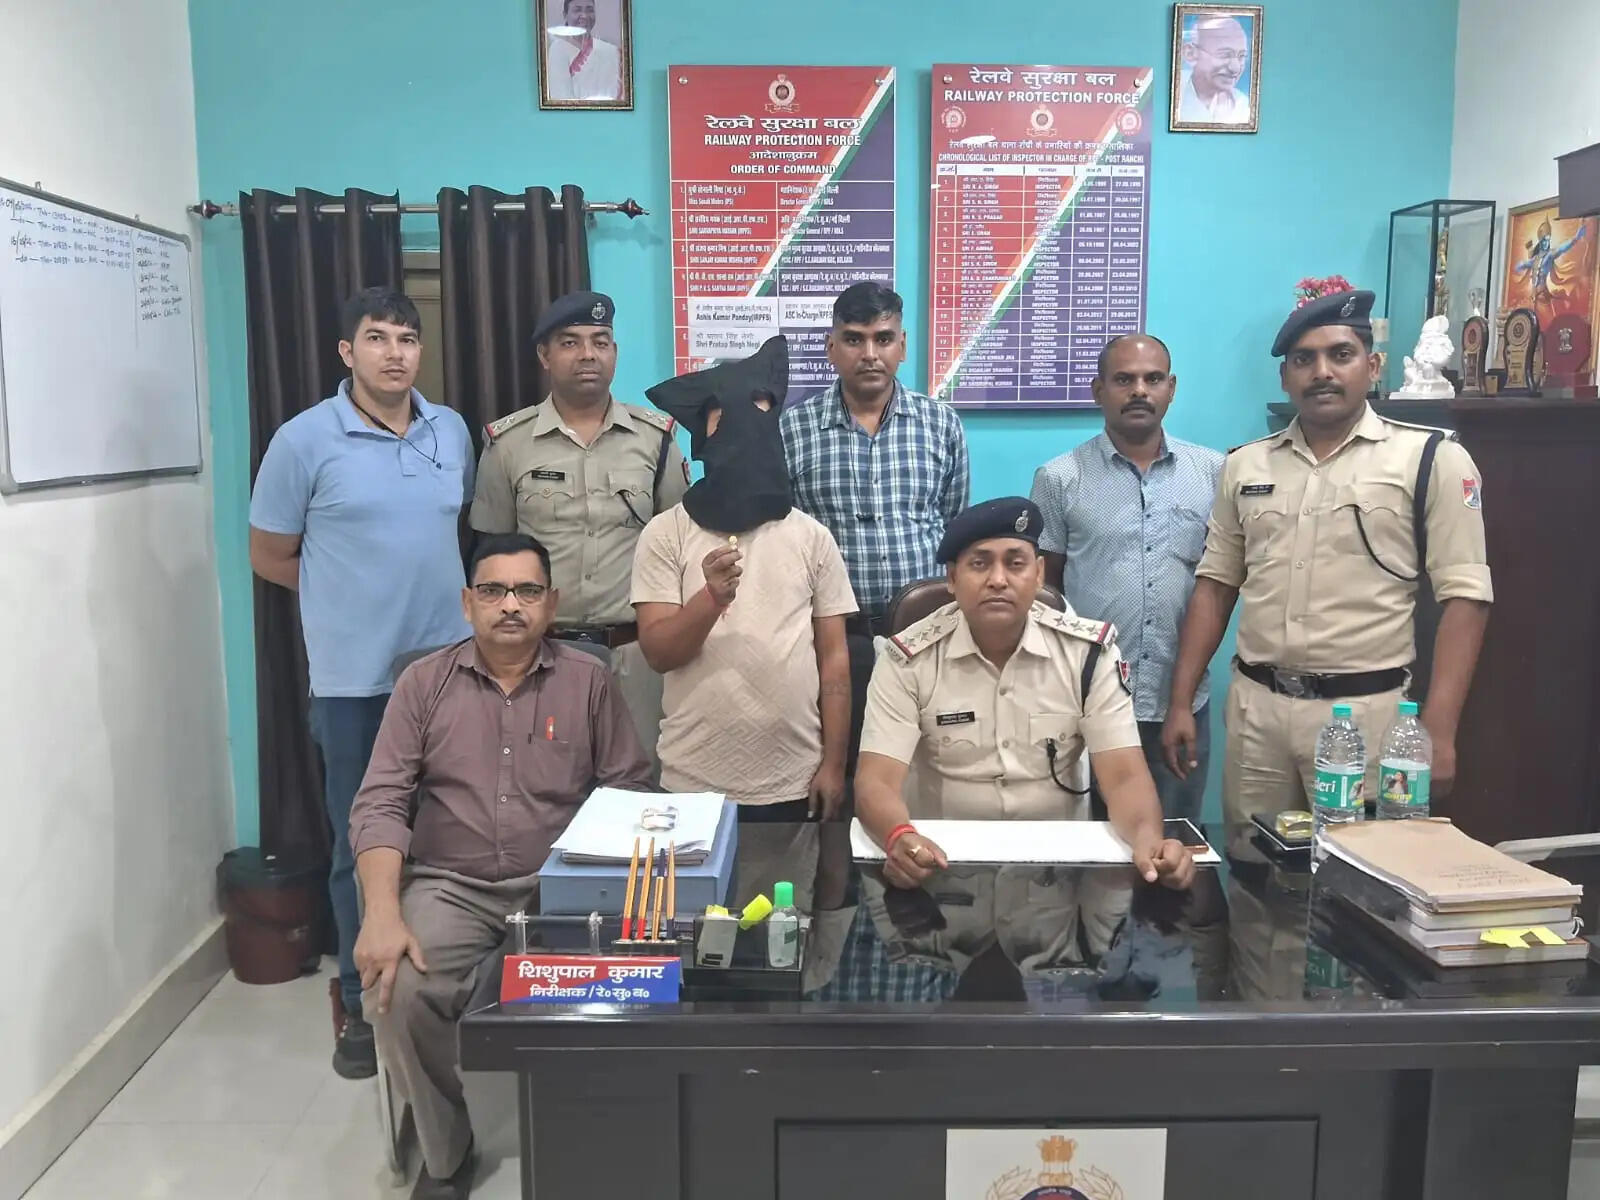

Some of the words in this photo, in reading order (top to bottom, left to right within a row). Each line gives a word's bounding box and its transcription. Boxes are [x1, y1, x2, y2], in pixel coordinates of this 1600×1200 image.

[969, 67, 1013, 84] रेलवे
[1021, 71, 1076, 88] सुरक्षा
[1086, 72, 1116, 86] बल
[944, 90, 1004, 102] RAILWAY
[1008, 91, 1092, 103] PROTECTION
[1096, 92, 1140, 104] FORCE
[704, 115, 755, 130] रेलवे
[760, 117, 818, 132] सुरक्षा
[823, 118, 862, 129] बल
[704, 134, 751, 146] RAILWAY
[755, 134, 822, 146] PROTECTION
[825, 135, 861, 146] FORCE
[938, 154, 986, 162] CHRONOLOGICAL
[988, 154, 1001, 162] LIST
[1002, 154, 1011, 162] OF
[1012, 154, 1044, 162] INSPECTOR
[1046, 154, 1052, 162] IN
[1054, 154, 1077, 163] CHARGE
[1078, 155, 1086, 163] OF
[1105, 155, 1121, 163] POST
[1122, 155, 1144, 164] RANCHI
[731, 164, 764, 174] ORDER
[768, 164, 780, 174] OF
[783, 164, 836, 174] COMMAND
[518, 961, 597, 982] शिशुपाल
[608, 966, 664, 984] कुमार
